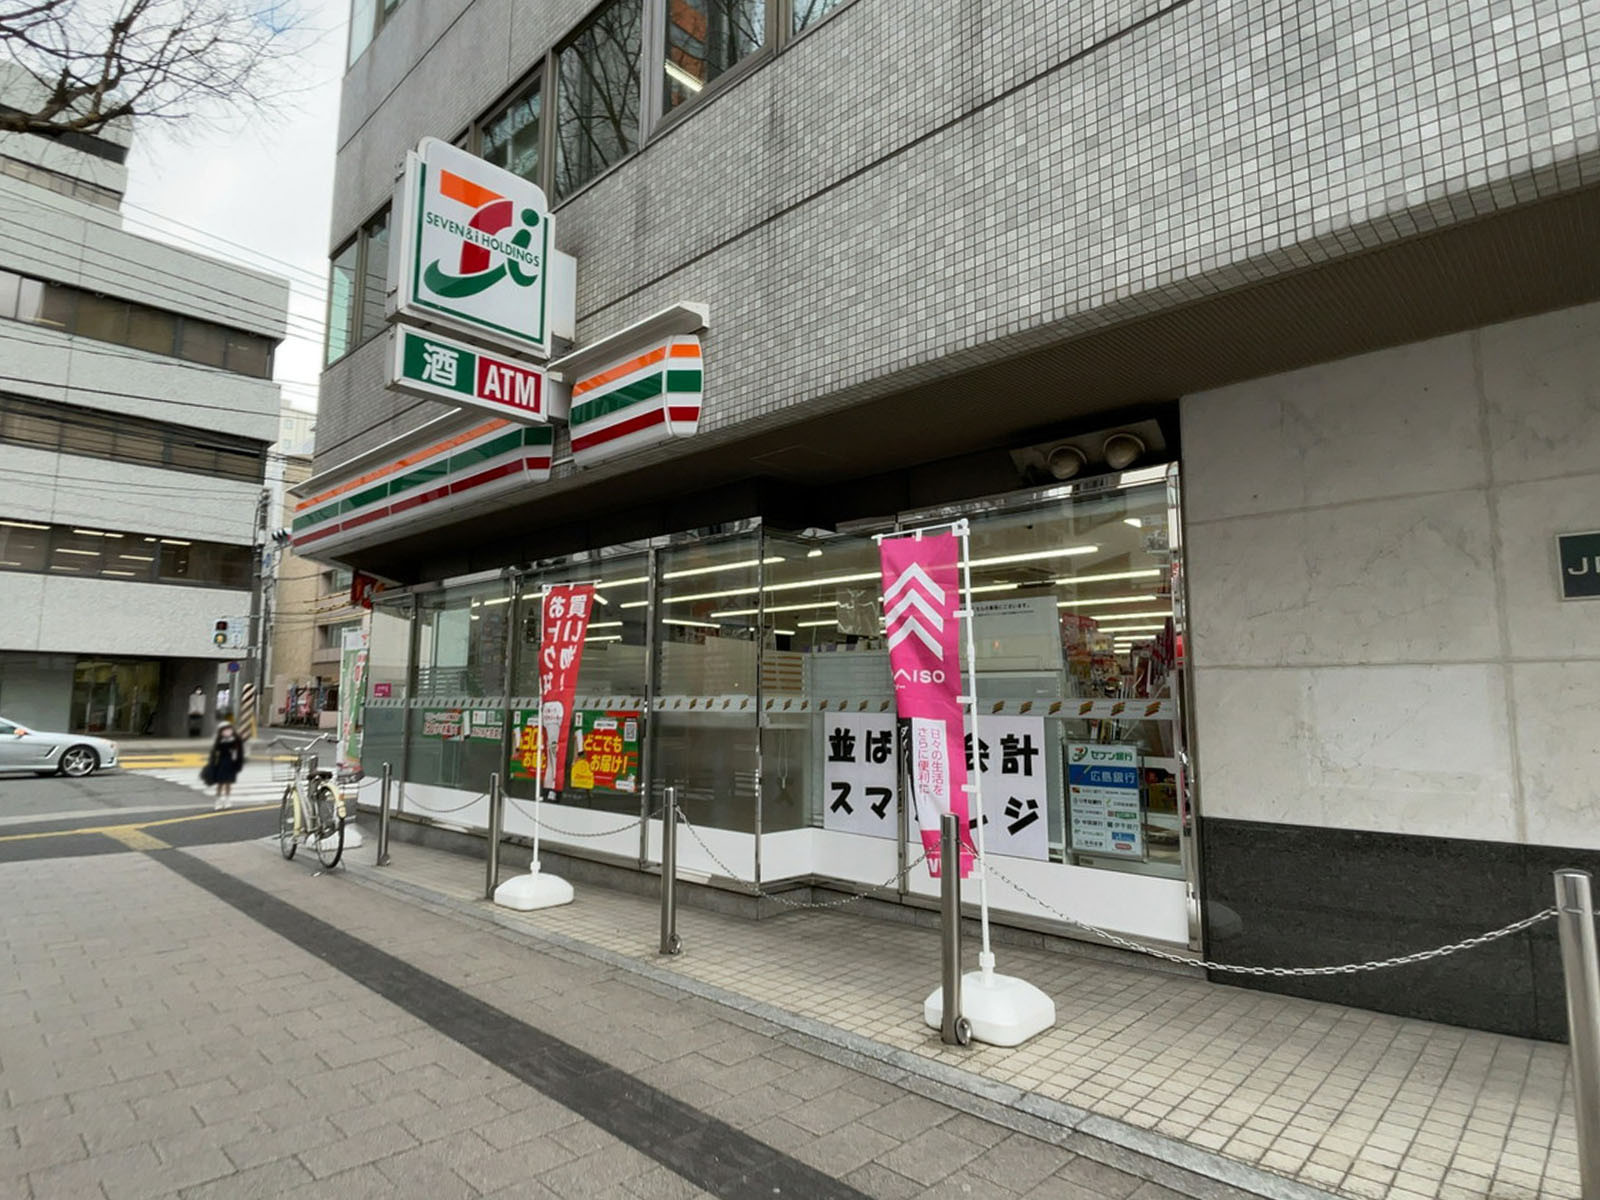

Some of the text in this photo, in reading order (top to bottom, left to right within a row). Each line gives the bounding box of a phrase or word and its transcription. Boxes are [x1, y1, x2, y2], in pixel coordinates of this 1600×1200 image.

[481, 234, 540, 267] HOLDINGS
[421, 342, 460, 387] 酒
[484, 364, 536, 408] ATM
[583, 734, 623, 752] どこでも
[1090, 750, 1133, 761] セブン銀行
[1090, 770, 1136, 784] 広島銀行
